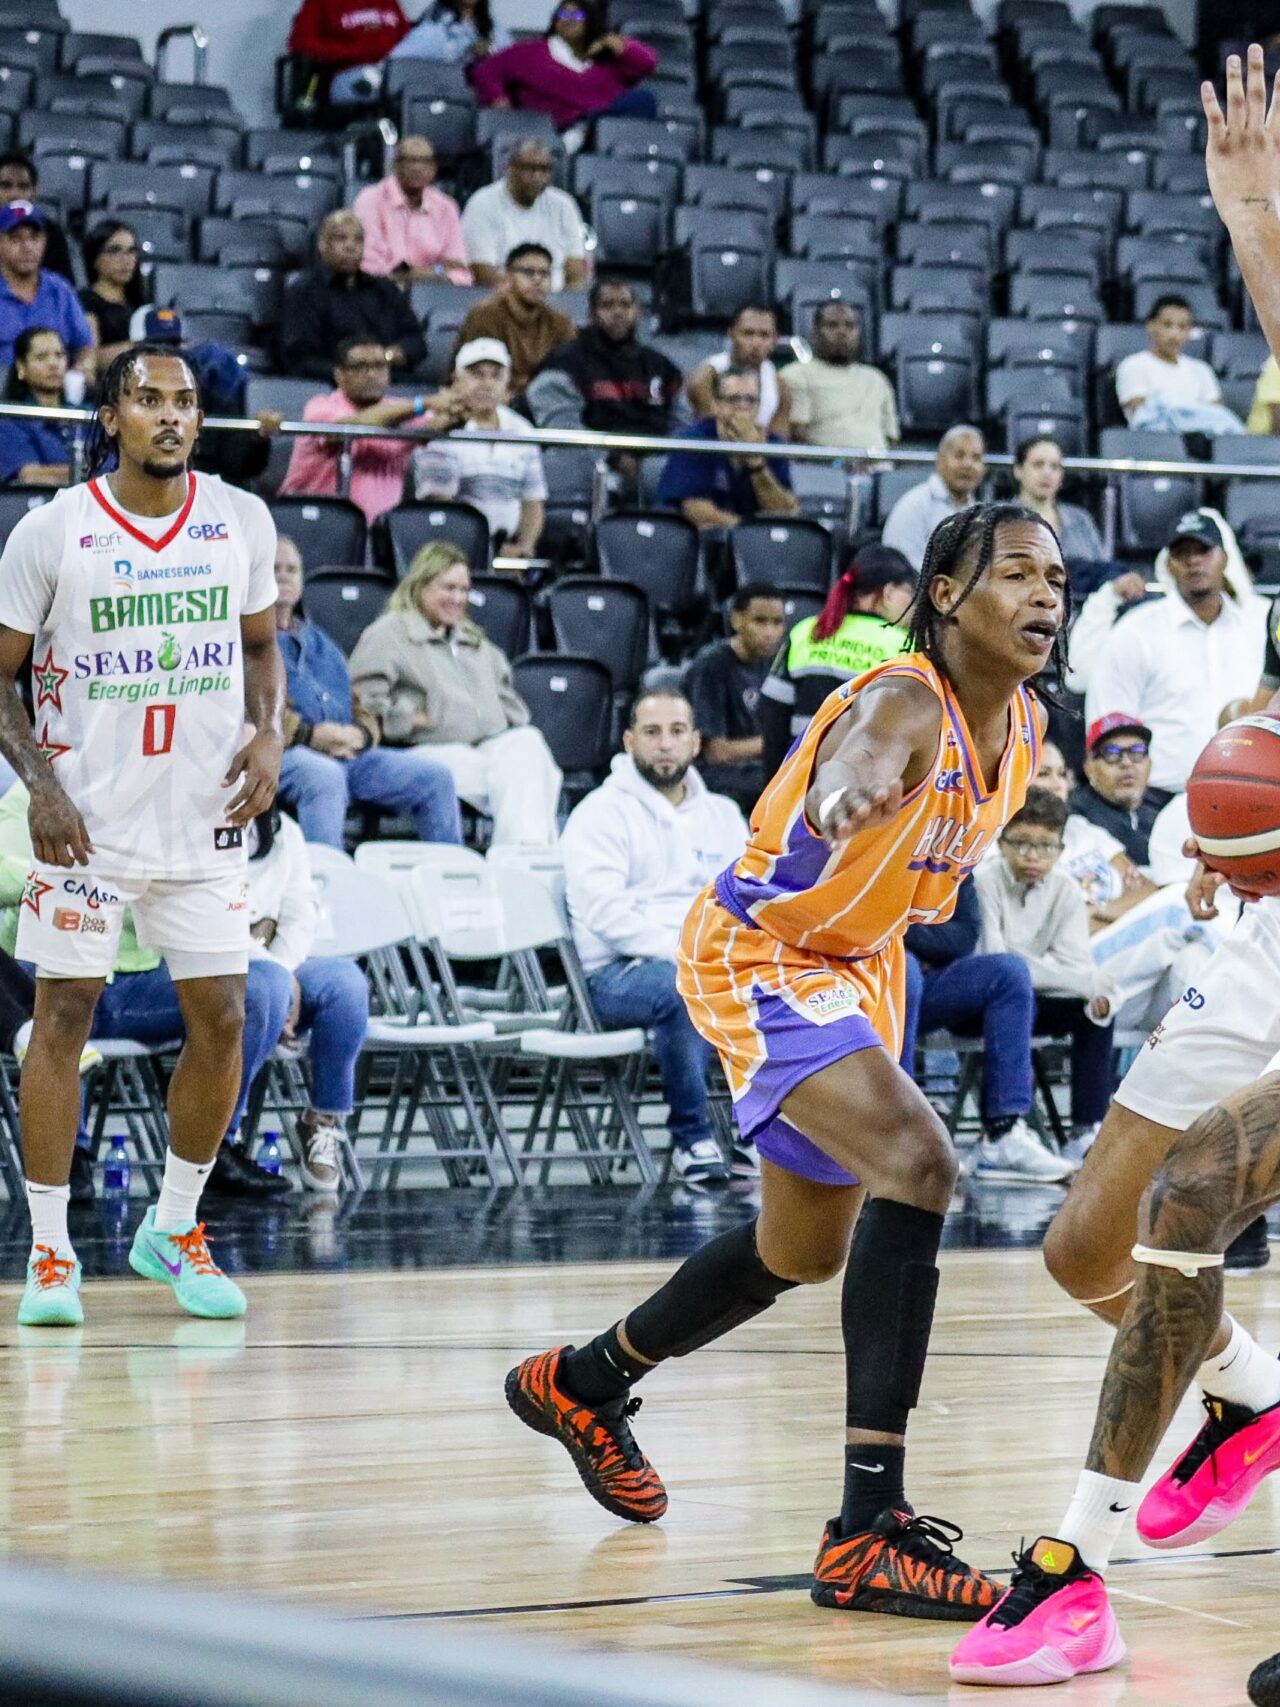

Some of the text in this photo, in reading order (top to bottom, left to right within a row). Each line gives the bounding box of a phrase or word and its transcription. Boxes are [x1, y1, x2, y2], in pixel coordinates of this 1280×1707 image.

[188, 523, 227, 540] GBC
[137, 564, 212, 580] BANRESERVAS
[90, 585, 229, 634] BAMESO
